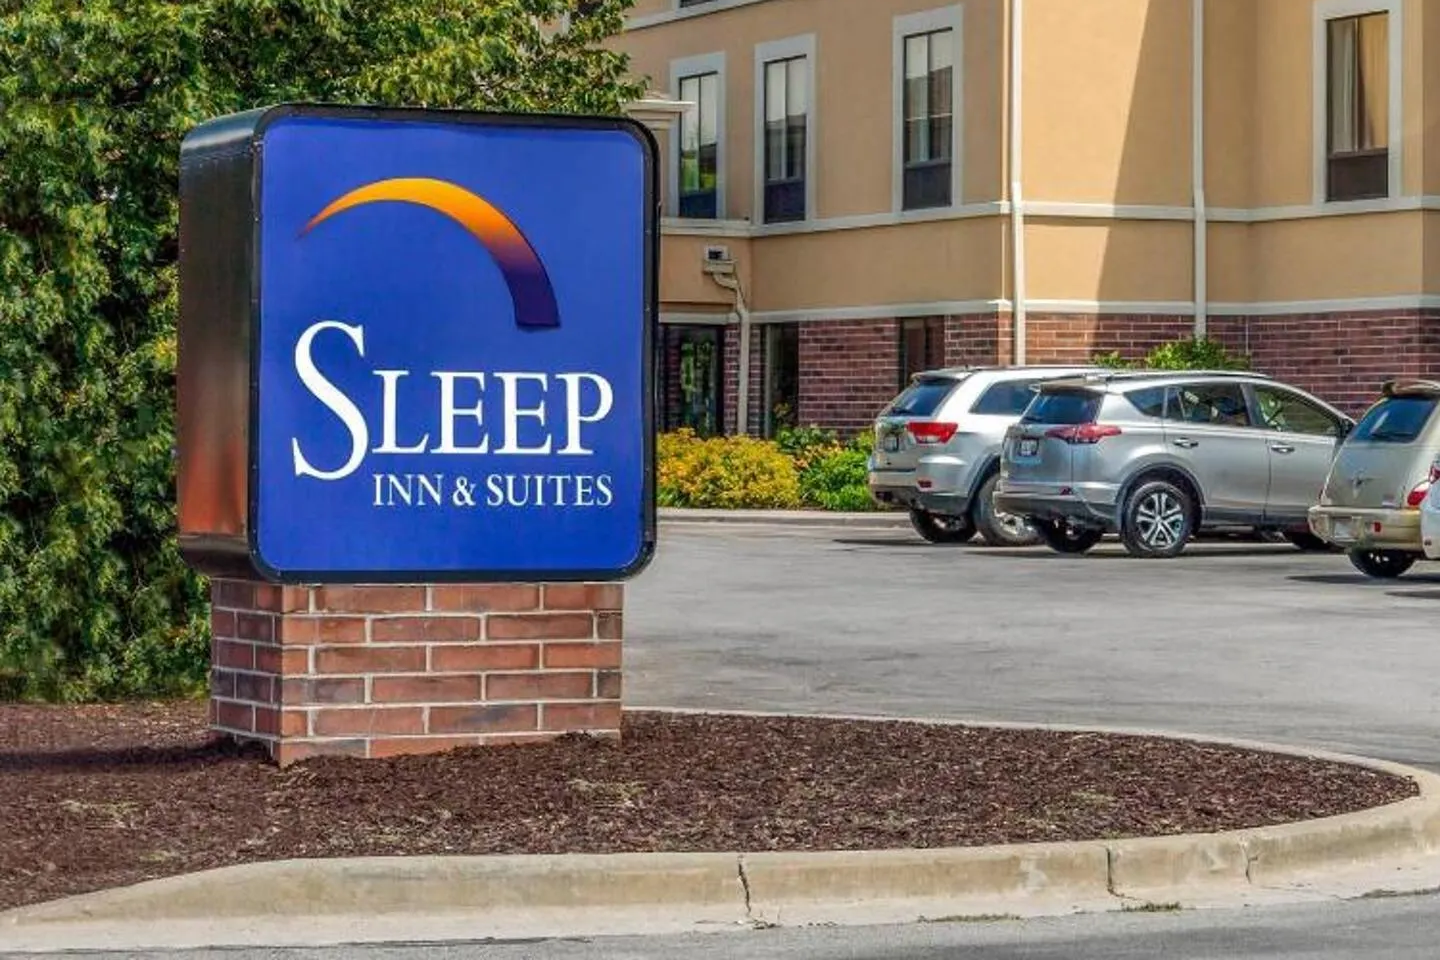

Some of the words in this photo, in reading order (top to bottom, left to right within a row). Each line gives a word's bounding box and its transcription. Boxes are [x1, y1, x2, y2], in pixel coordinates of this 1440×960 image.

[292, 320, 614, 481] SLEEP
[372, 473, 444, 507] INN
[452, 476, 476, 507] &
[486, 473, 613, 507] SUITES
